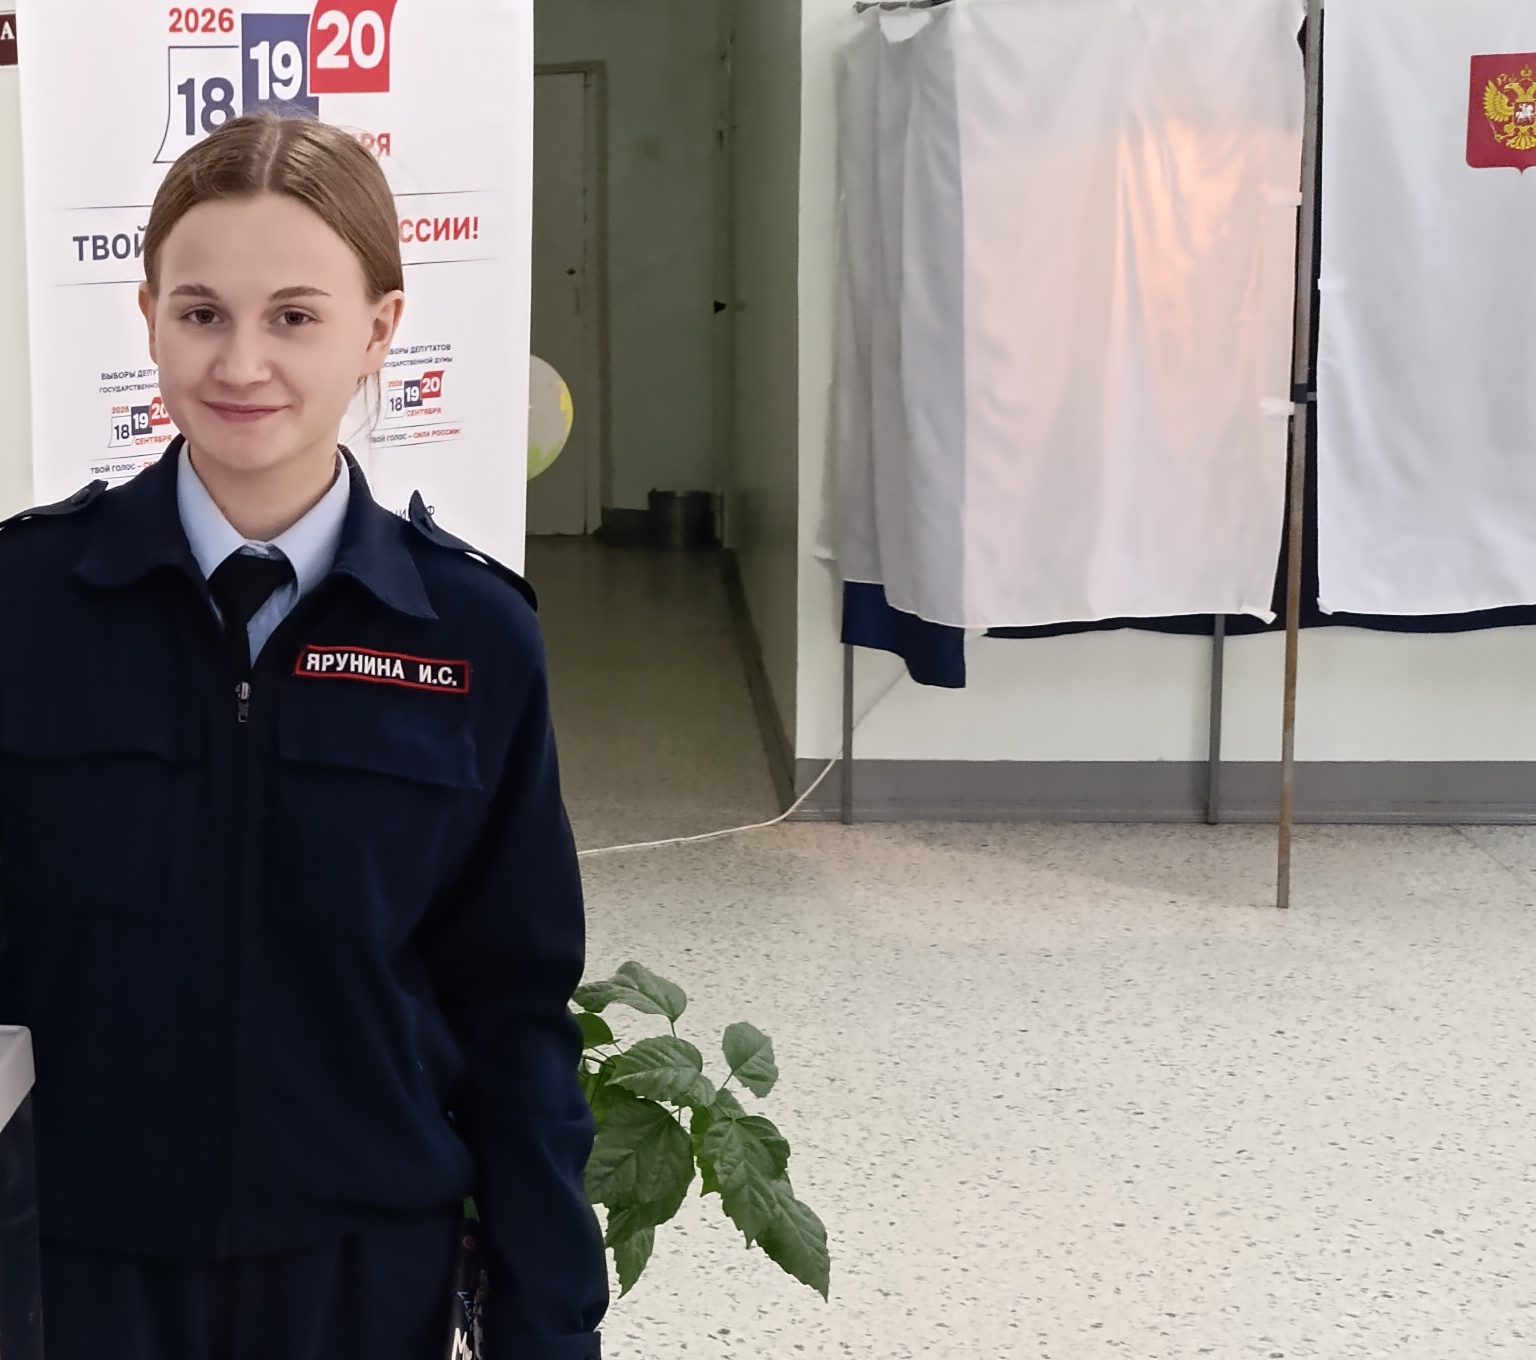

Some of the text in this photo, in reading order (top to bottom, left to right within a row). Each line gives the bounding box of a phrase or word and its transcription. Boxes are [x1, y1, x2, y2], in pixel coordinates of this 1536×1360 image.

[169, 7, 235, 33] 2026
[177, 10, 385, 136] 18 19 20
[399, 216, 479, 243] ССИИ!
[99, 382, 159, 393] ГОСУДАРСТВЕННО
[101, 370, 136, 380] ВЫБОРЫ
[390, 376, 441, 412] 18 19 20
[114, 424, 130, 440] 18
[132, 412, 149, 430] 19
[90, 464, 110, 475] ТВОЙ
[112, 463, 135, 472] ГОЛОС
[306, 652, 458, 687] ЯРУНИНА И.С.
